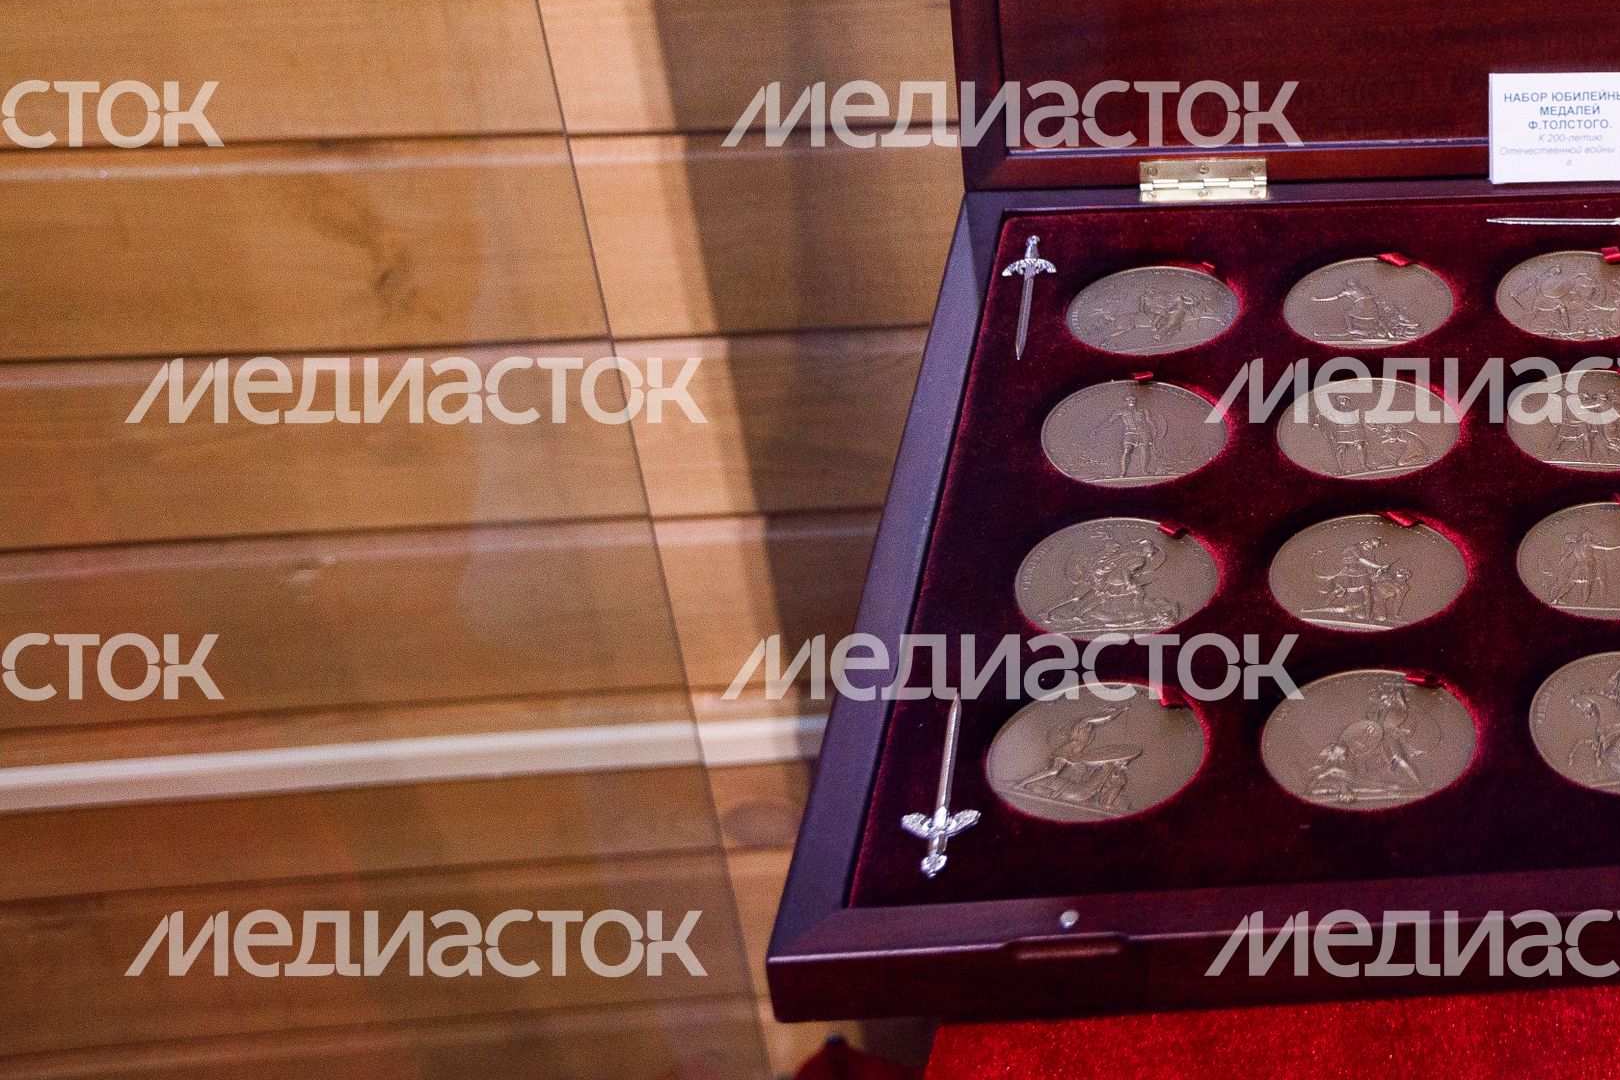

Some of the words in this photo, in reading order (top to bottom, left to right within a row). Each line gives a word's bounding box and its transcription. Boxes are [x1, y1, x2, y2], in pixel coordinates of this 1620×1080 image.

[1504, 92, 1548, 102] НАБОР
[1539, 104, 1600, 117] МЕДАЛЕЙ
[1528, 119, 1612, 130] Ф.ТОЛСТОГО.
